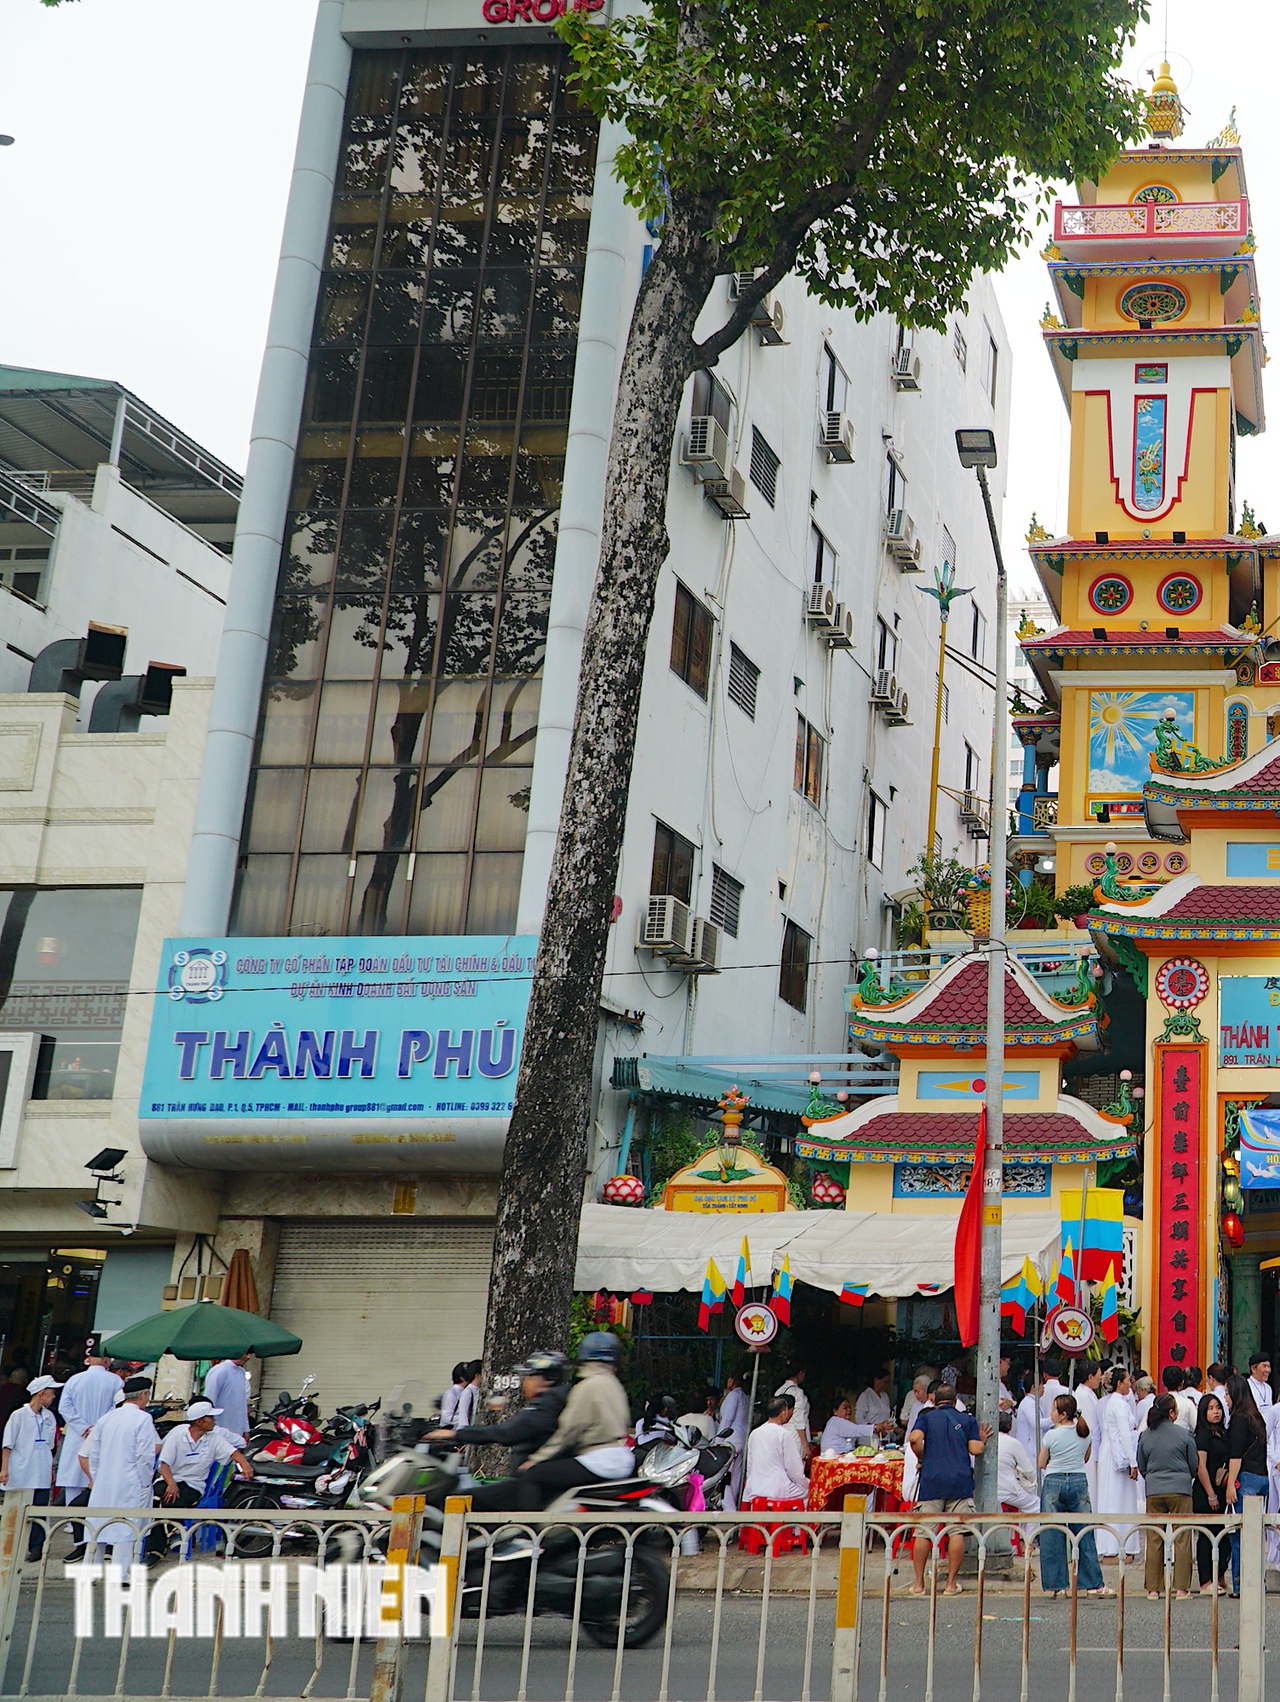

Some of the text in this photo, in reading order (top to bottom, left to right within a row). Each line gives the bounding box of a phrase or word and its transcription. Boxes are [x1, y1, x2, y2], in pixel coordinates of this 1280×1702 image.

[236, 956, 266, 974] CÔNG
[269, 957, 282, 974] TY
[335, 954, 354, 976] TẬP
[358, 954, 388, 974] ĐOÀN
[392, 952, 413, 973] ĐẦU
[417, 956, 432, 973] TƯ
[490, 957, 499, 972] &
[328, 981, 353, 998] KINH
[356, 980, 392, 997] DOANH
[1220, 1020, 1269, 1049] THÁNH
[174, 1019, 518, 1079] THÀNH PHÚ
[1223, 1055, 1239, 1065] 891
[1244, 1053, 1271, 1065] TRẦN
[493, 1375, 520, 1389] 395
